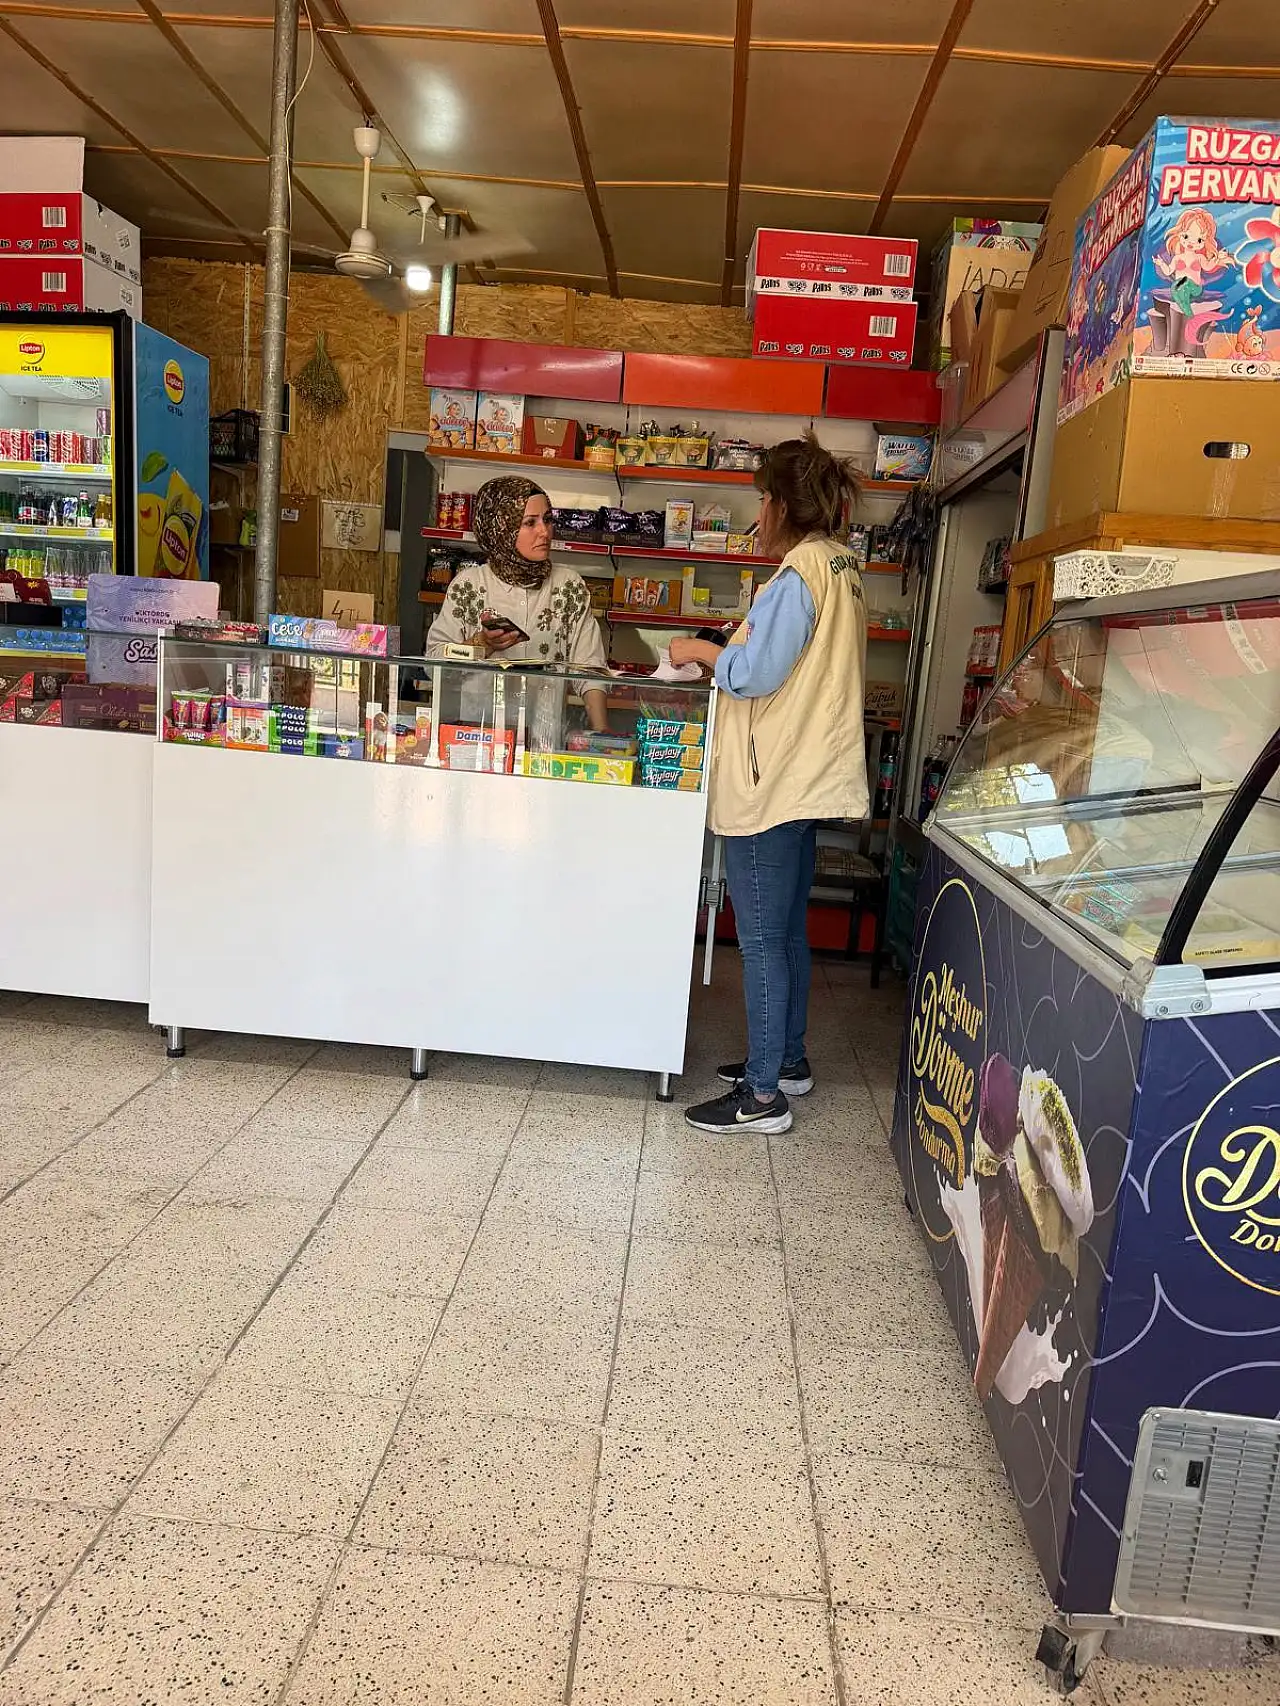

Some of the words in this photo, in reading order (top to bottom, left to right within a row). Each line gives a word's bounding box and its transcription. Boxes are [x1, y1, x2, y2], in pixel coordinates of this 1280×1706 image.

[1102, 158, 1144, 224] RÜZGAR
[20, 344, 41, 353] Lipton
[166, 373, 183, 391] Lipton
[165, 529, 187, 561] Lipton
[281, 712, 305, 720] POLO
[282, 725, 306, 733] POLO
[282, 738, 304, 746] POLO
[456, 731, 493, 743] Damla
[644, 745, 682, 760] Haylayf
[938, 963, 983, 1041] Meşhur
[914, 1091, 957, 1177] Dondurma
